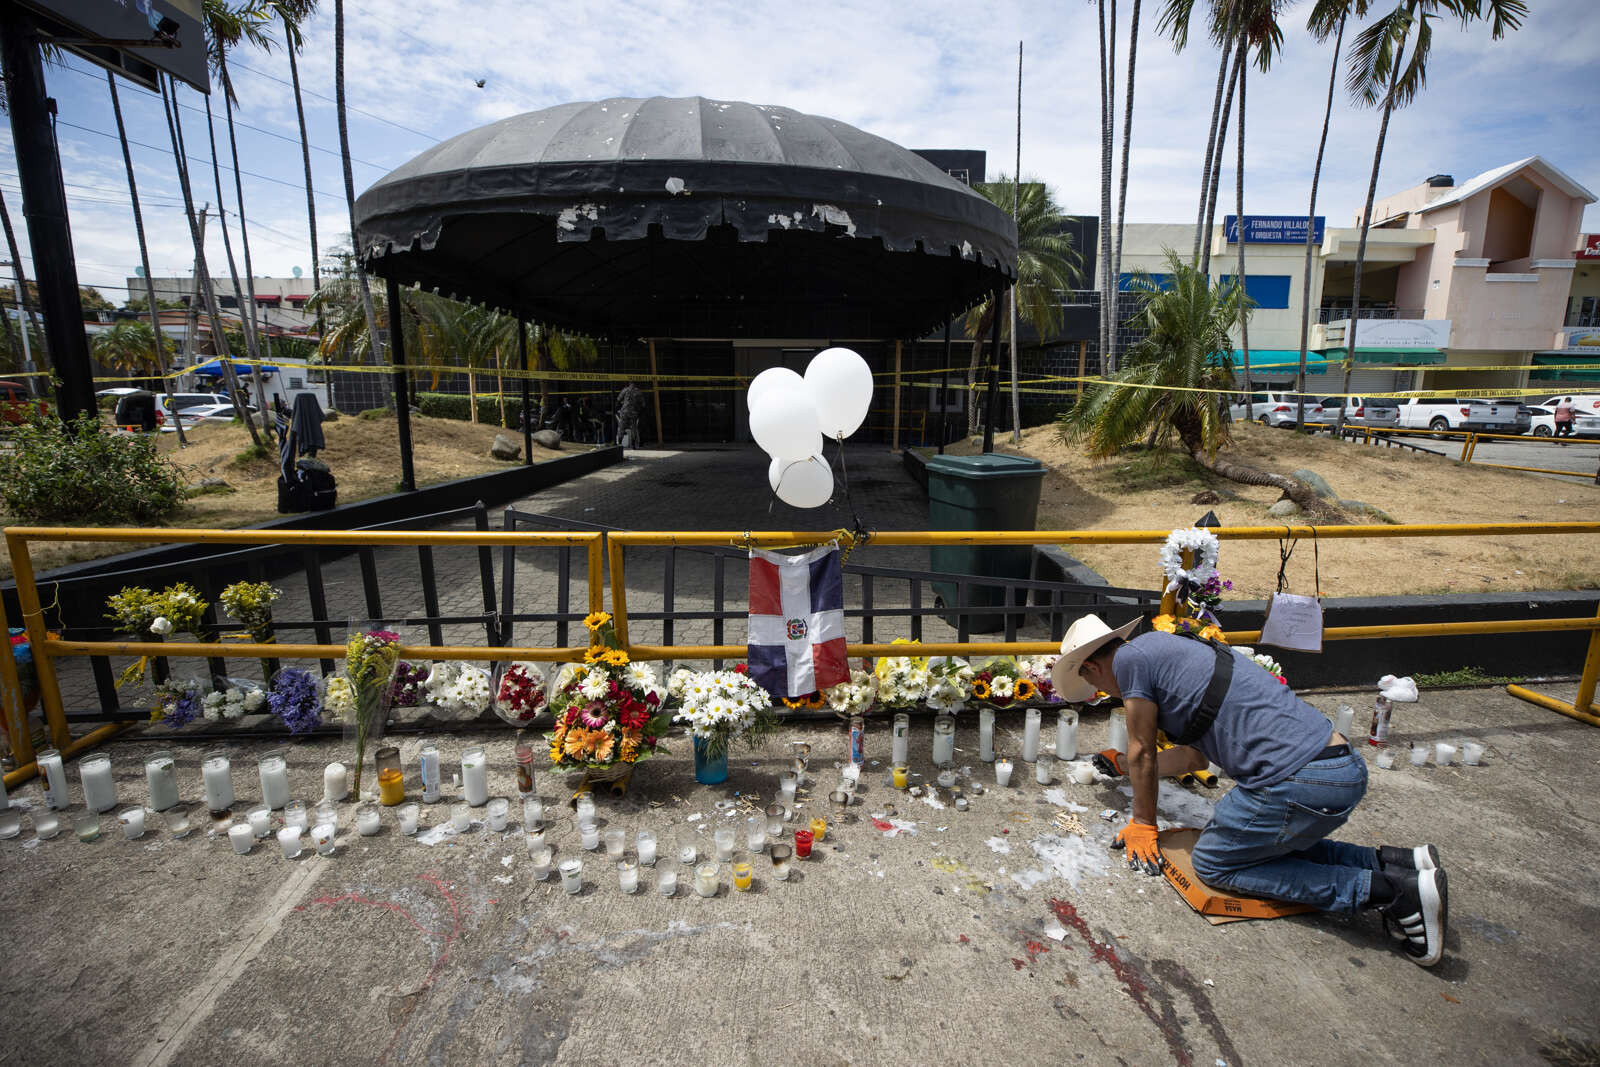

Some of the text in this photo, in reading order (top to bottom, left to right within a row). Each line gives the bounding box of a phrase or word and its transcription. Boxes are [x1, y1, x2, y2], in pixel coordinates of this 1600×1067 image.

[1251, 221, 1310, 229] FERNANDO VILLALO
[1255, 231, 1282, 239] ORQUESTA
